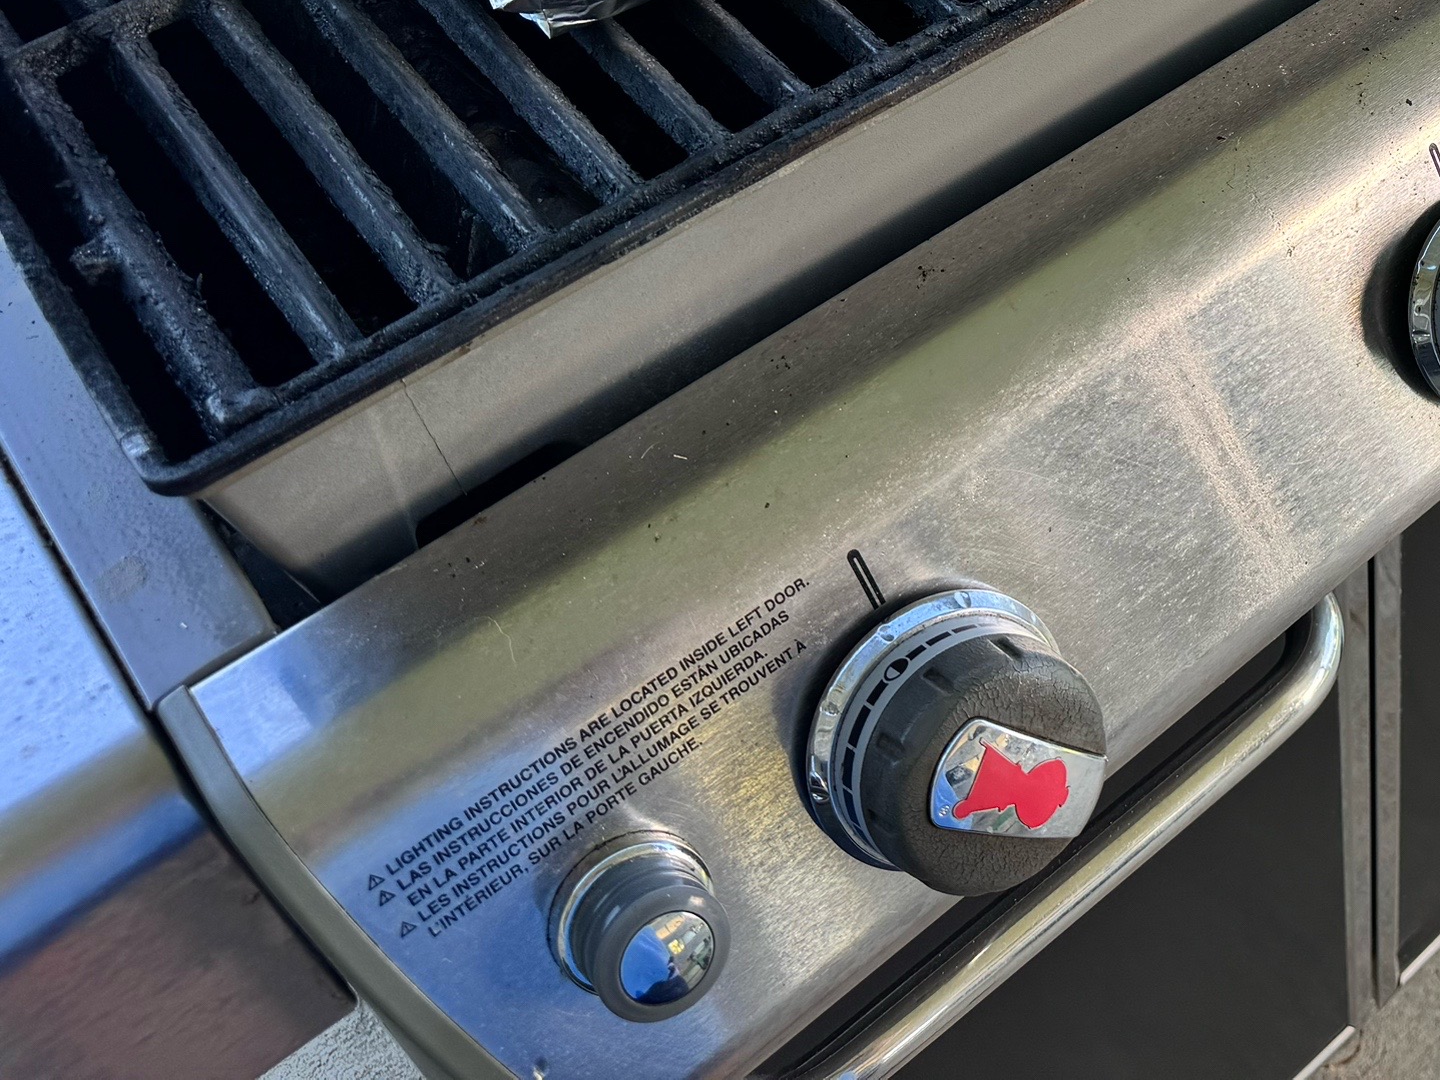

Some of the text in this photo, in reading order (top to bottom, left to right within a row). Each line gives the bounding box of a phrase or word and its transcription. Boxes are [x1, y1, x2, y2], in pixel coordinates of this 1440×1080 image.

[386, 578, 810, 875] LIGHTING INSTRUCTIONS ARE LOCATED INSIDE LEFT DOOR.
[396, 610, 790, 891] LAS INSTRUCCIONES DE ENCENDIDO ESTÁN UBICADAS
[406, 650, 768, 907] EN LA PARTE INTERIOR DE LA PUERTA IZQUIERDA.
[417, 893, 451, 922] LES
[451, 811, 566, 898] INSTRUCTIONS
[566, 779, 611, 815] POUR
[699, 700, 722, 720] SE
[719, 647, 794, 705] TROUVENT
[794, 638, 807, 654] À
[528, 836, 562, 865] SUR
[562, 821, 585, 841] LA
[585, 781, 637, 824] PORTE
[638, 736, 703, 786] GAUCHE.
